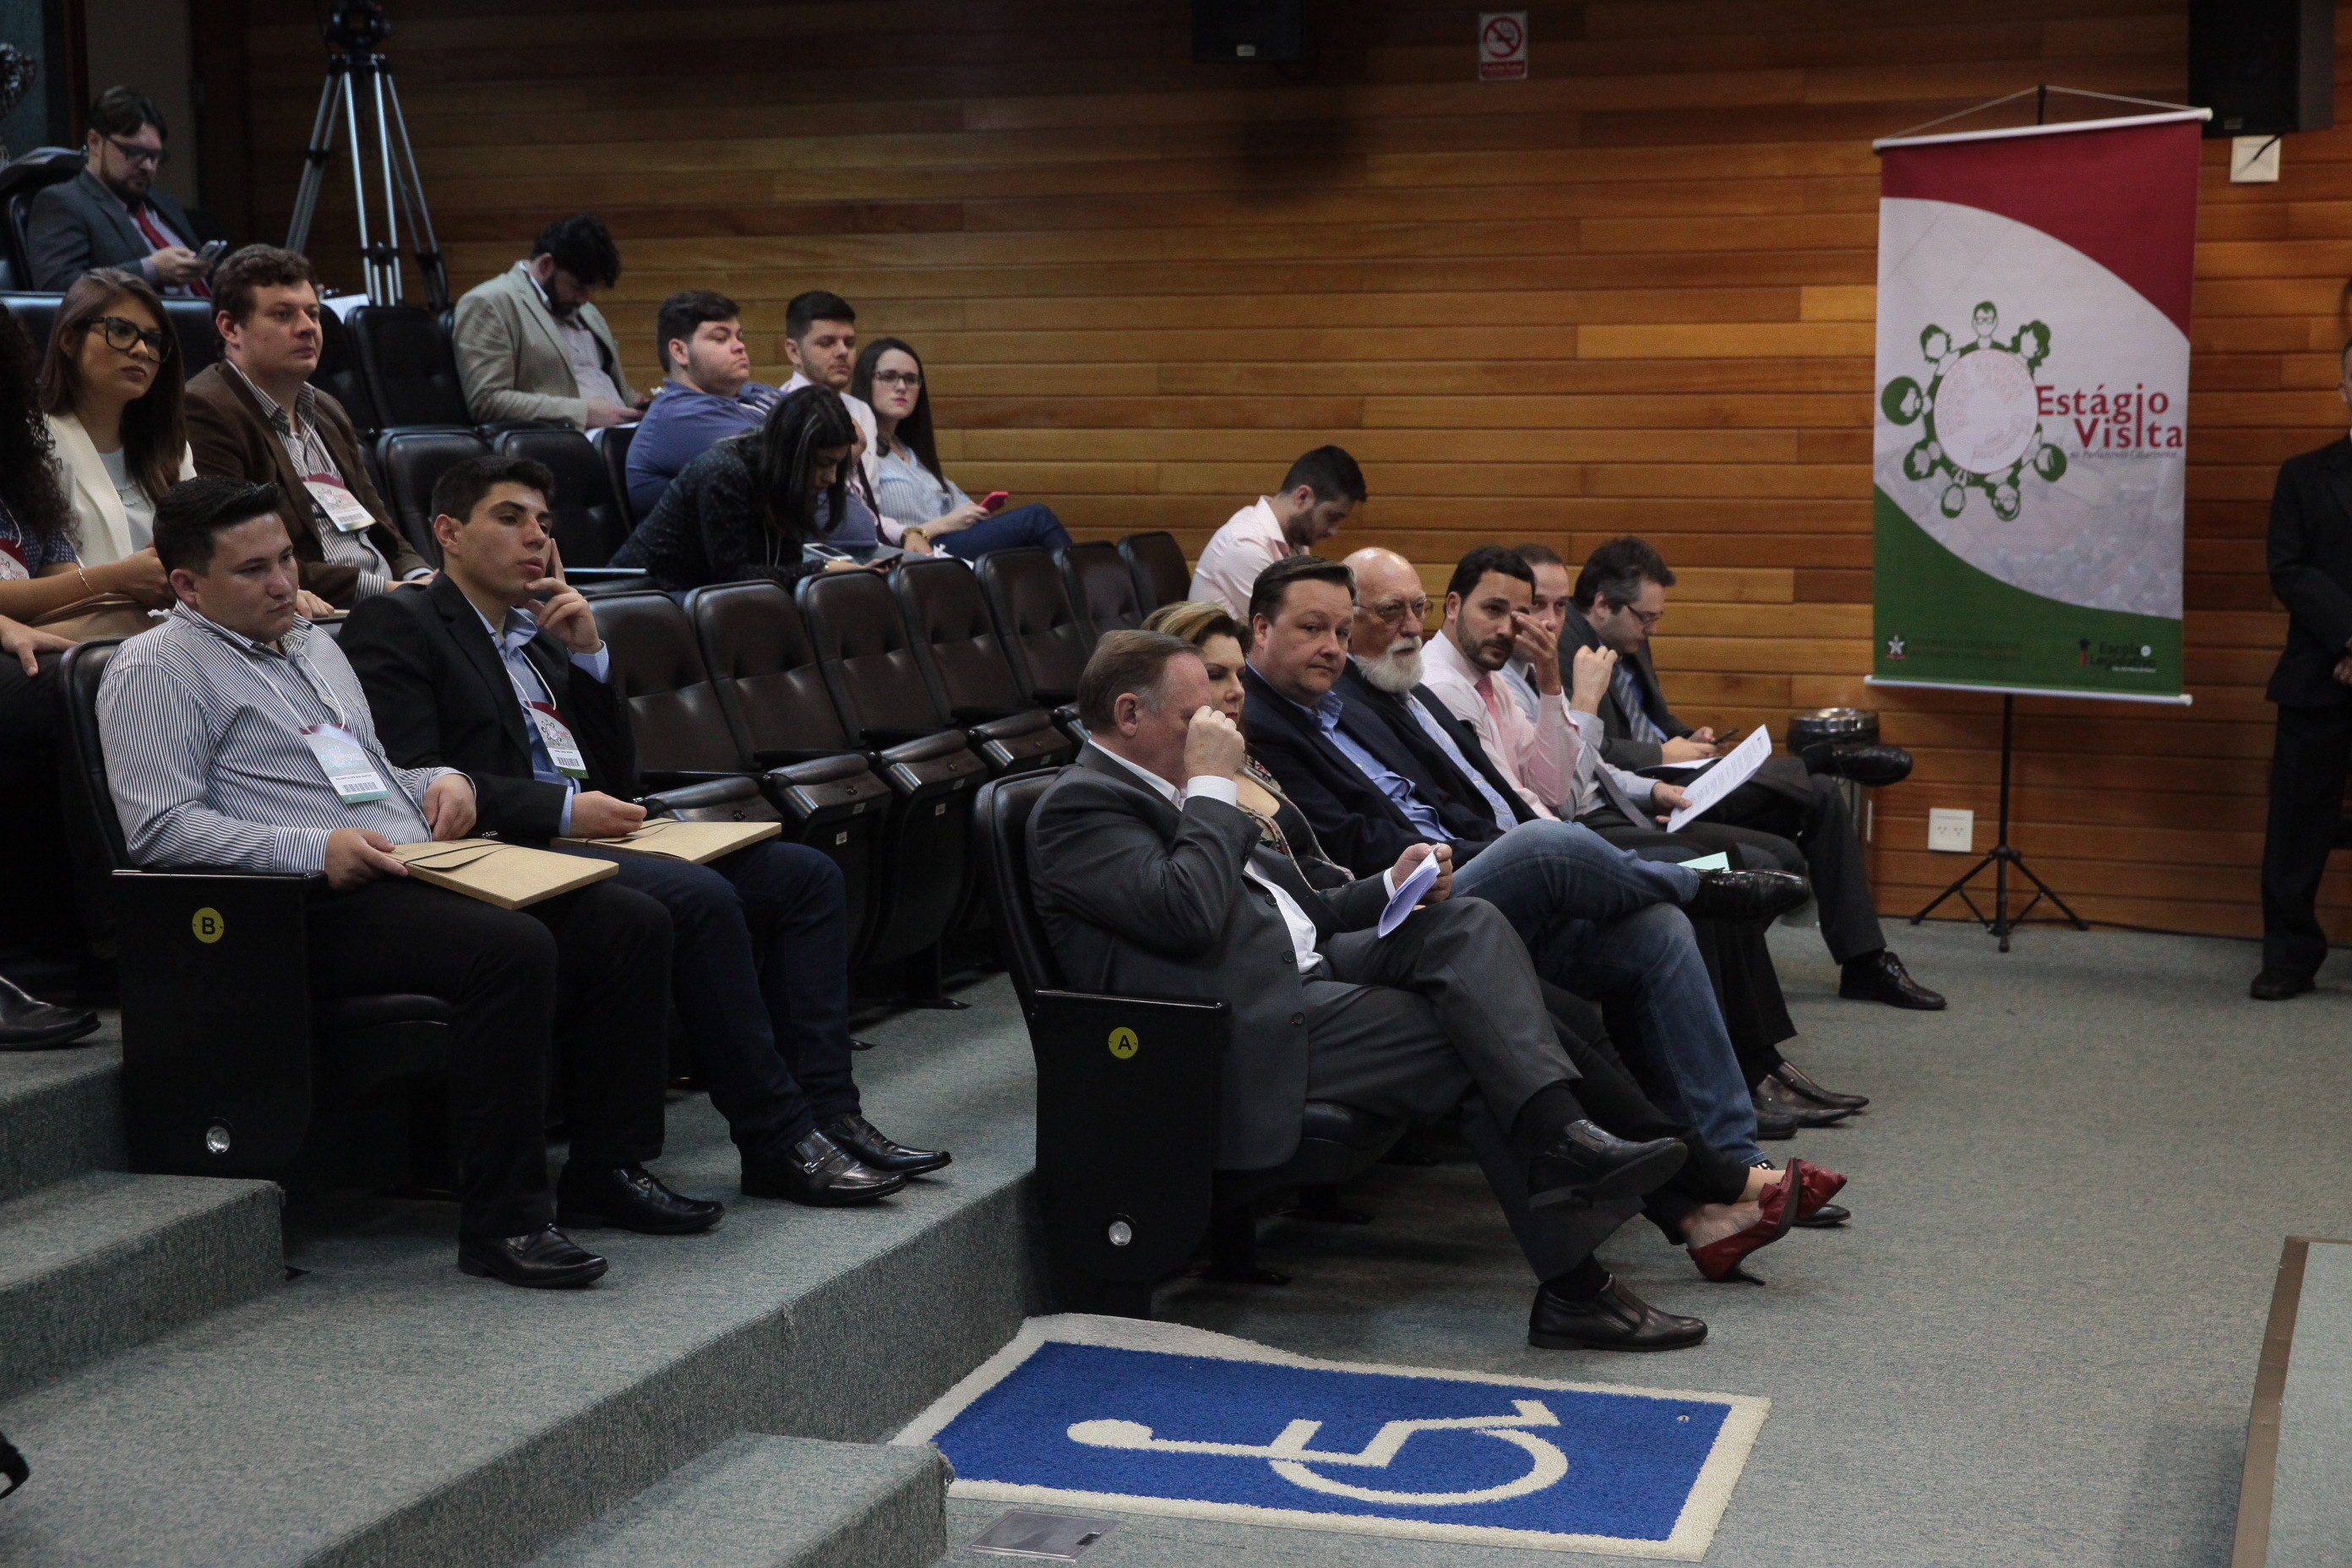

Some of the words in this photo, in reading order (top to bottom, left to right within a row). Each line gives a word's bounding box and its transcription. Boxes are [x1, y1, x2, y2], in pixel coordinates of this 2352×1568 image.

[2035, 383, 2169, 425] Estágio
[2073, 417, 2183, 449] Visita
[202, 916, 215, 935] B
[1118, 1034, 1132, 1051] A
